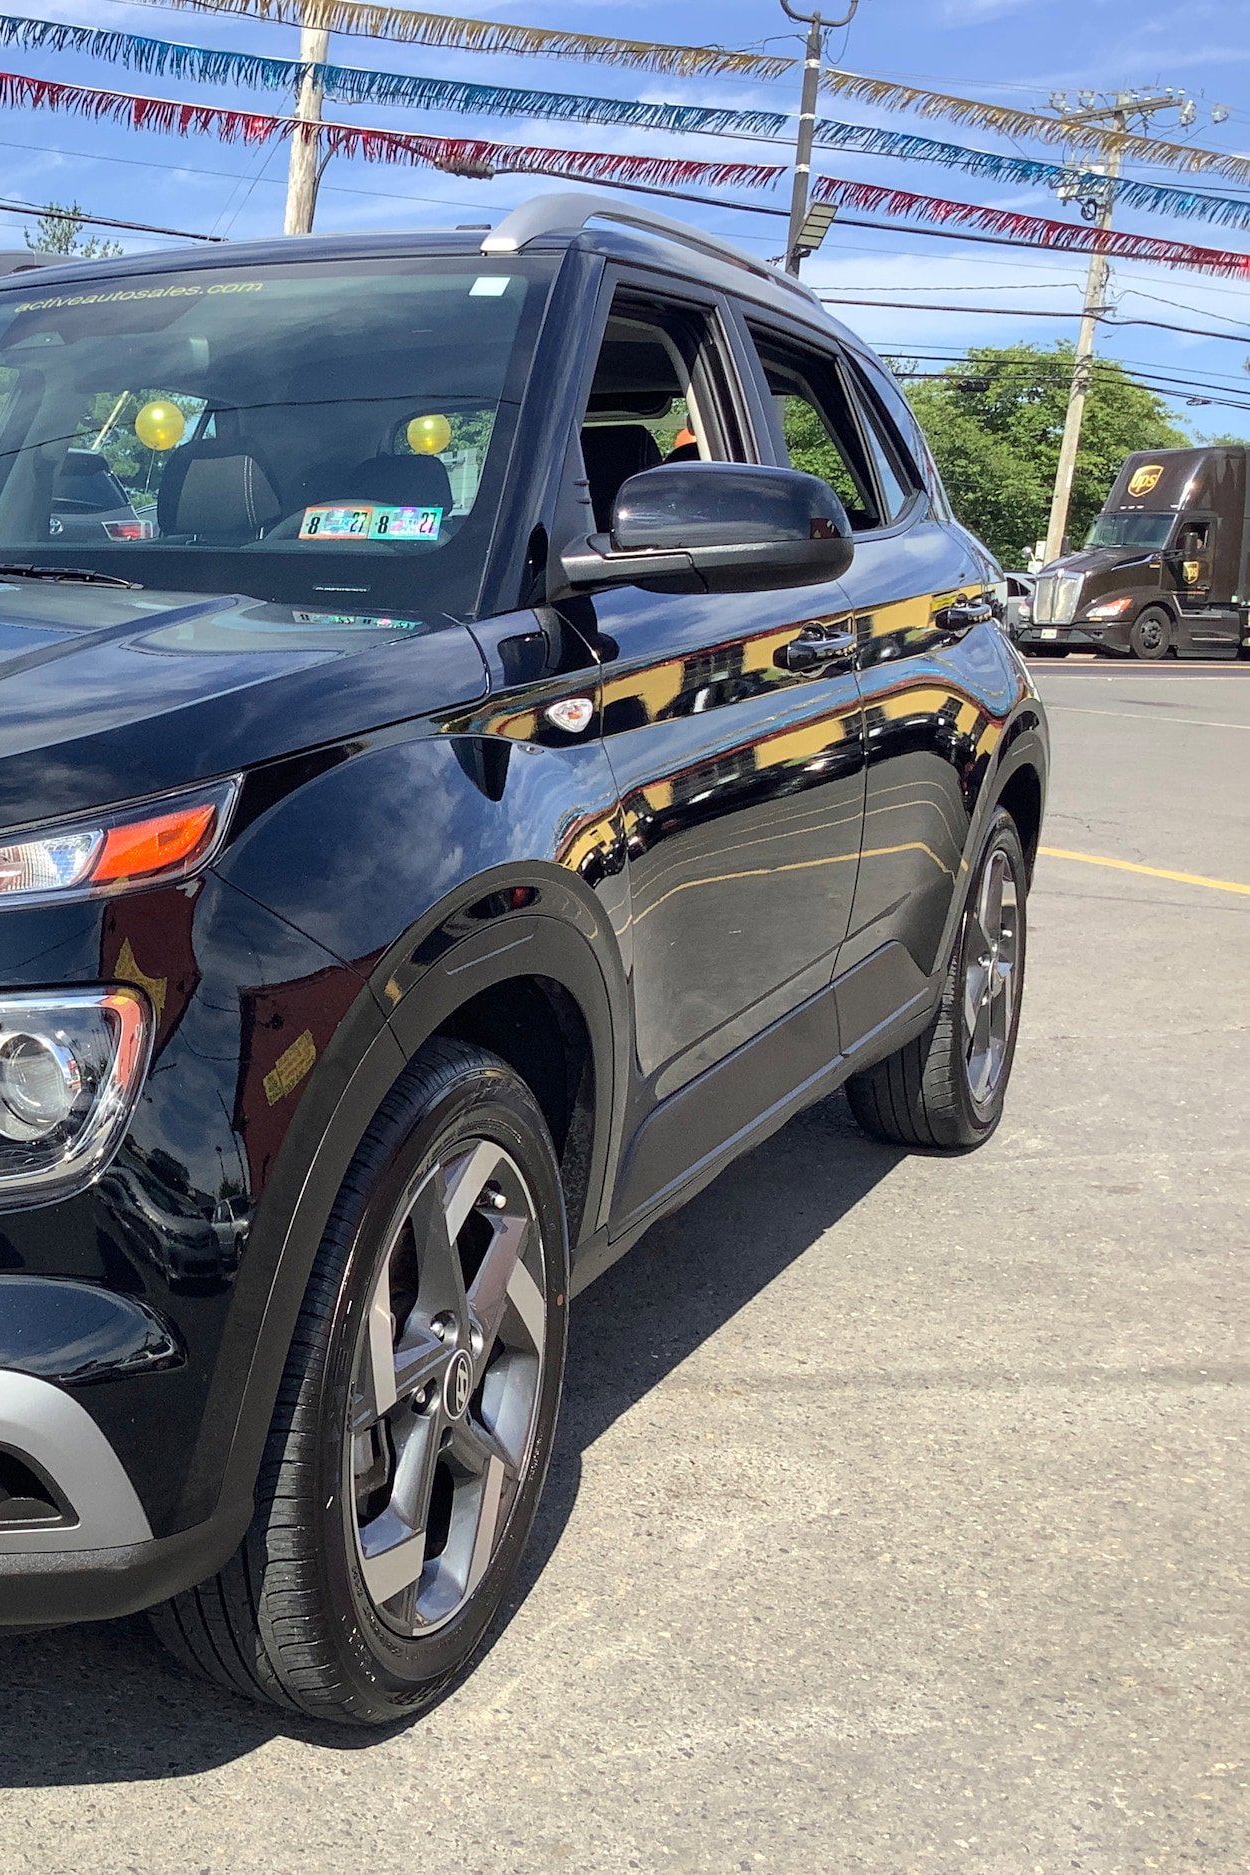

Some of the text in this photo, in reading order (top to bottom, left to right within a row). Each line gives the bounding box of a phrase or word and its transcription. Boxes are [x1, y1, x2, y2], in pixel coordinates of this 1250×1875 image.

[14, 282, 264, 314] activeautosales.com
[307, 511, 368, 535] 8 27
[377, 512, 437, 534] 8 27
